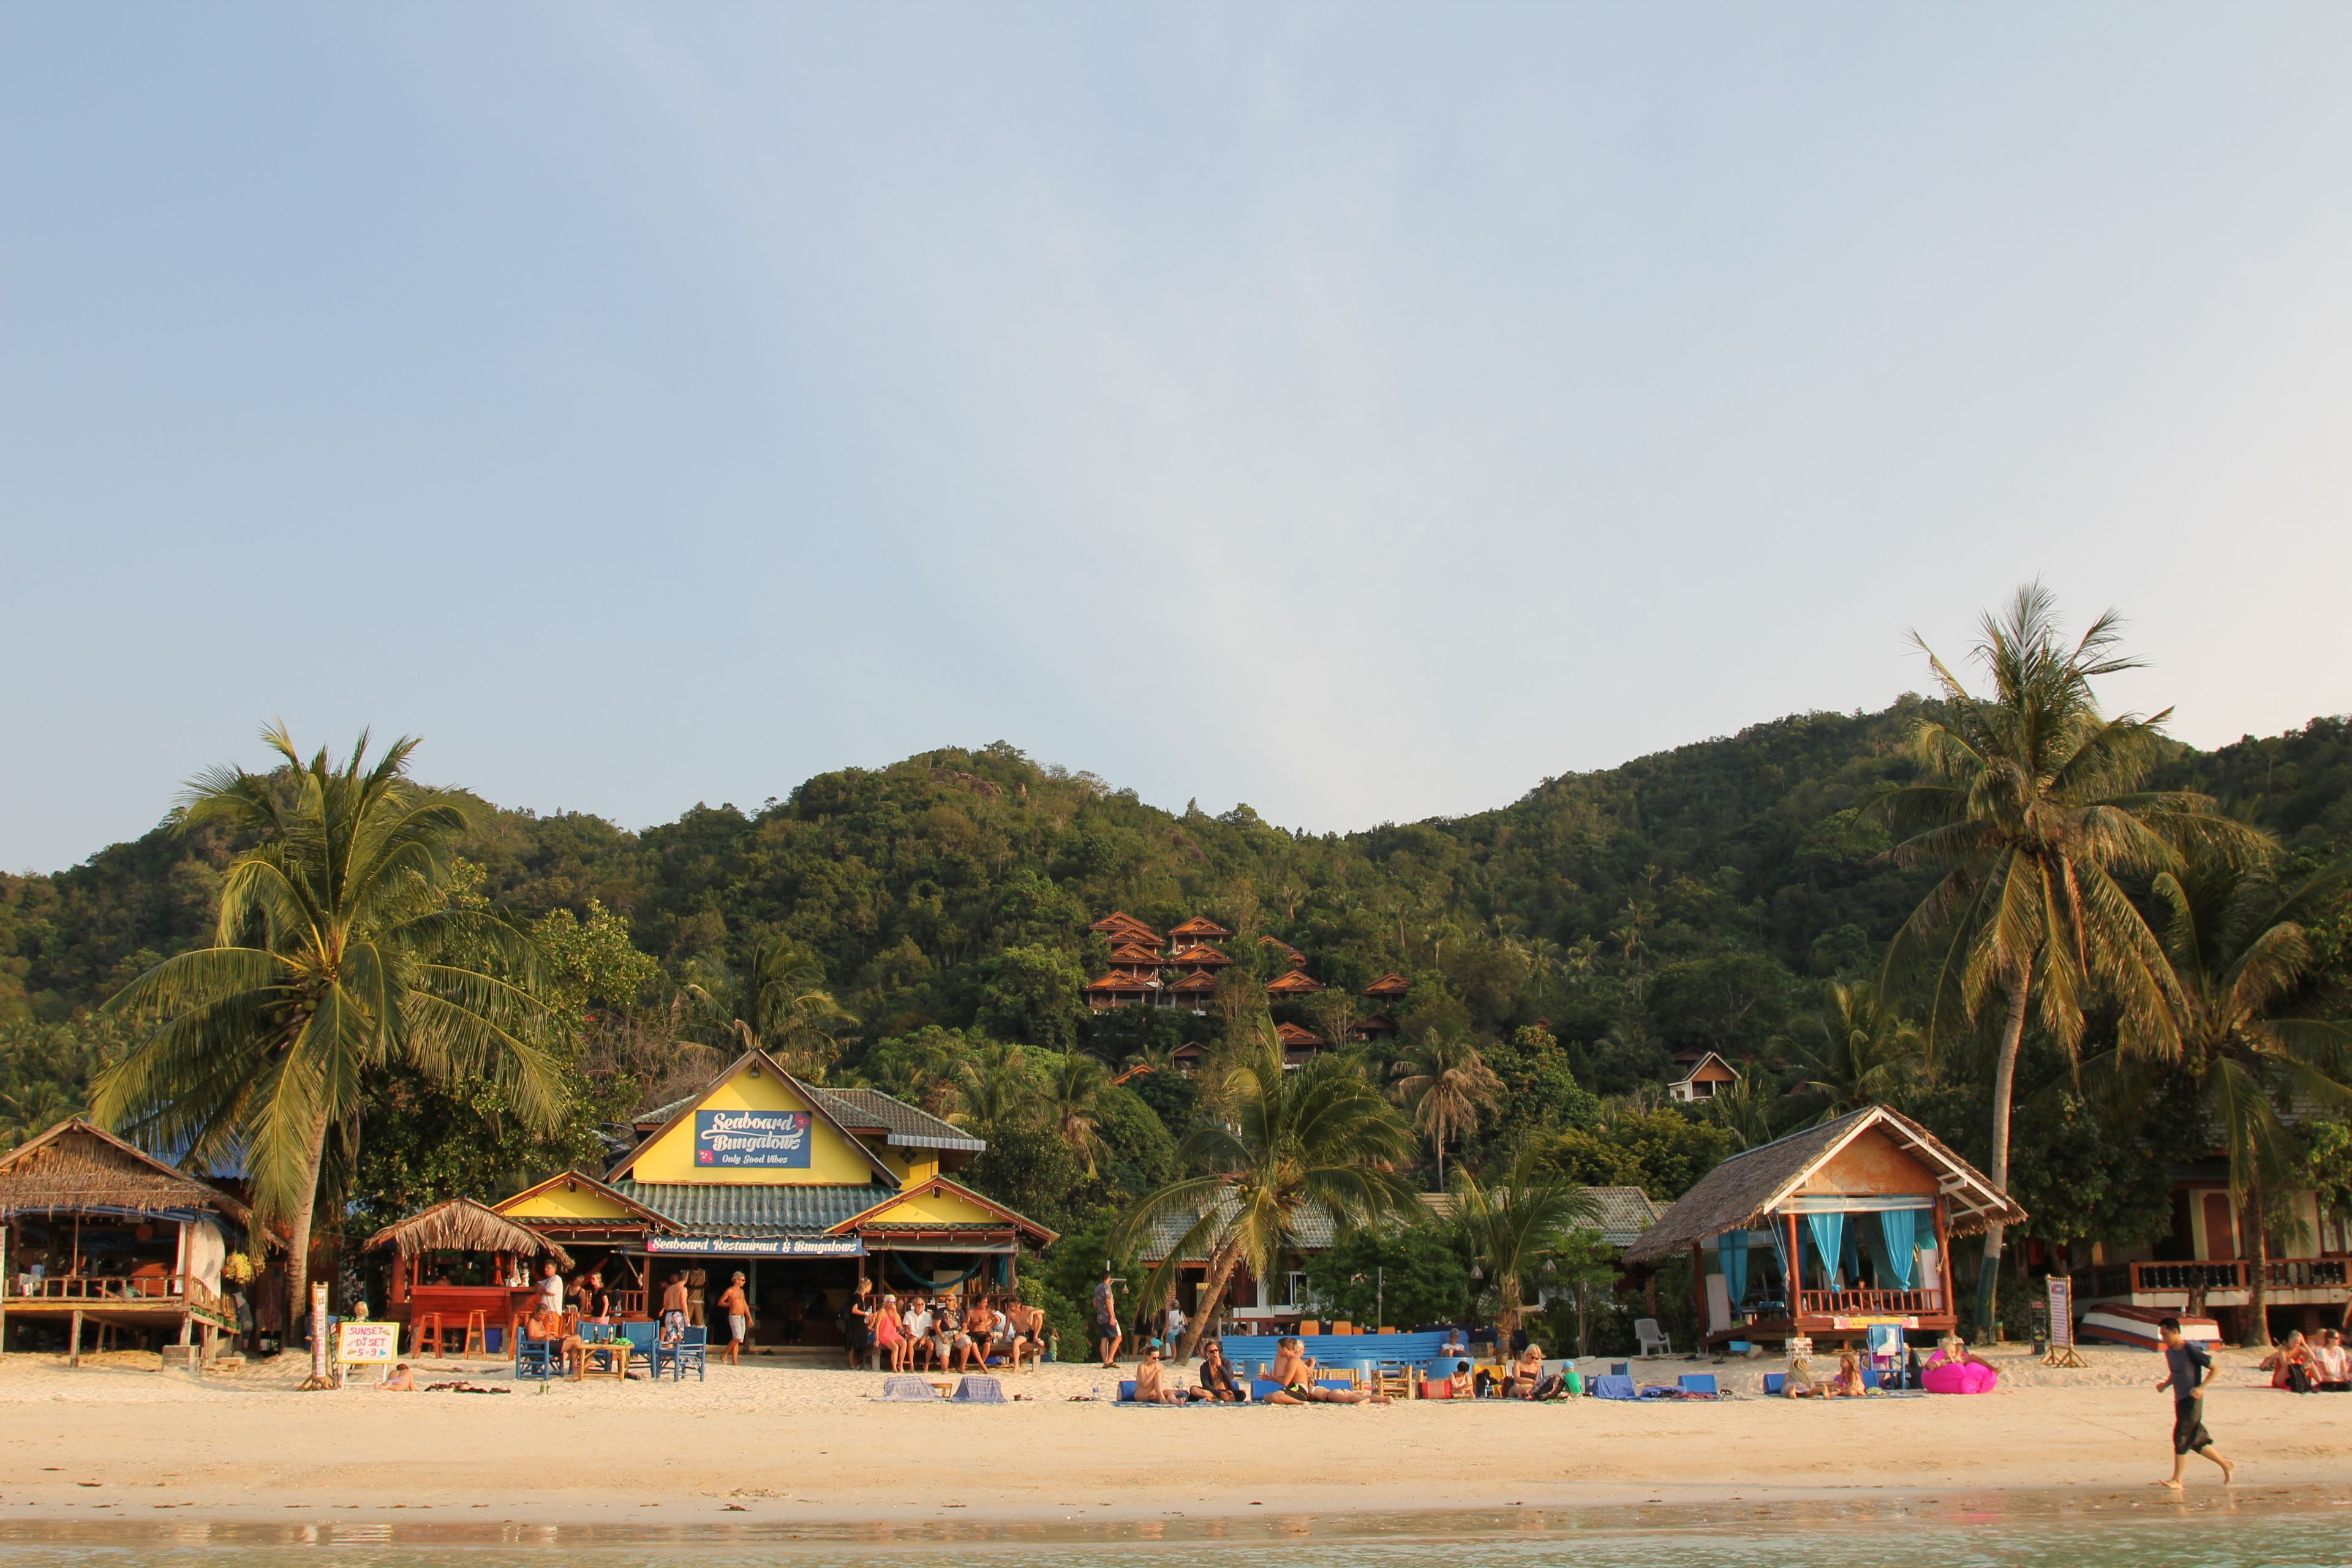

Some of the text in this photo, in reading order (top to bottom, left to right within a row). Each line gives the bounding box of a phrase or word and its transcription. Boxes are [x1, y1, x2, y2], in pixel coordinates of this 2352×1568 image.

[713, 1112, 796, 1131] Seaboard
[712, 1131, 801, 1153] Bungalows
[722, 1154, 741, 1164] Only
[767, 1155, 788, 1164] Vibes
[652, 1237, 857, 1254] Seaboard Restaurant & Bungalows
[349, 1327, 383, 1335] SUNSET
[355, 1338, 367, 1346] DJ
